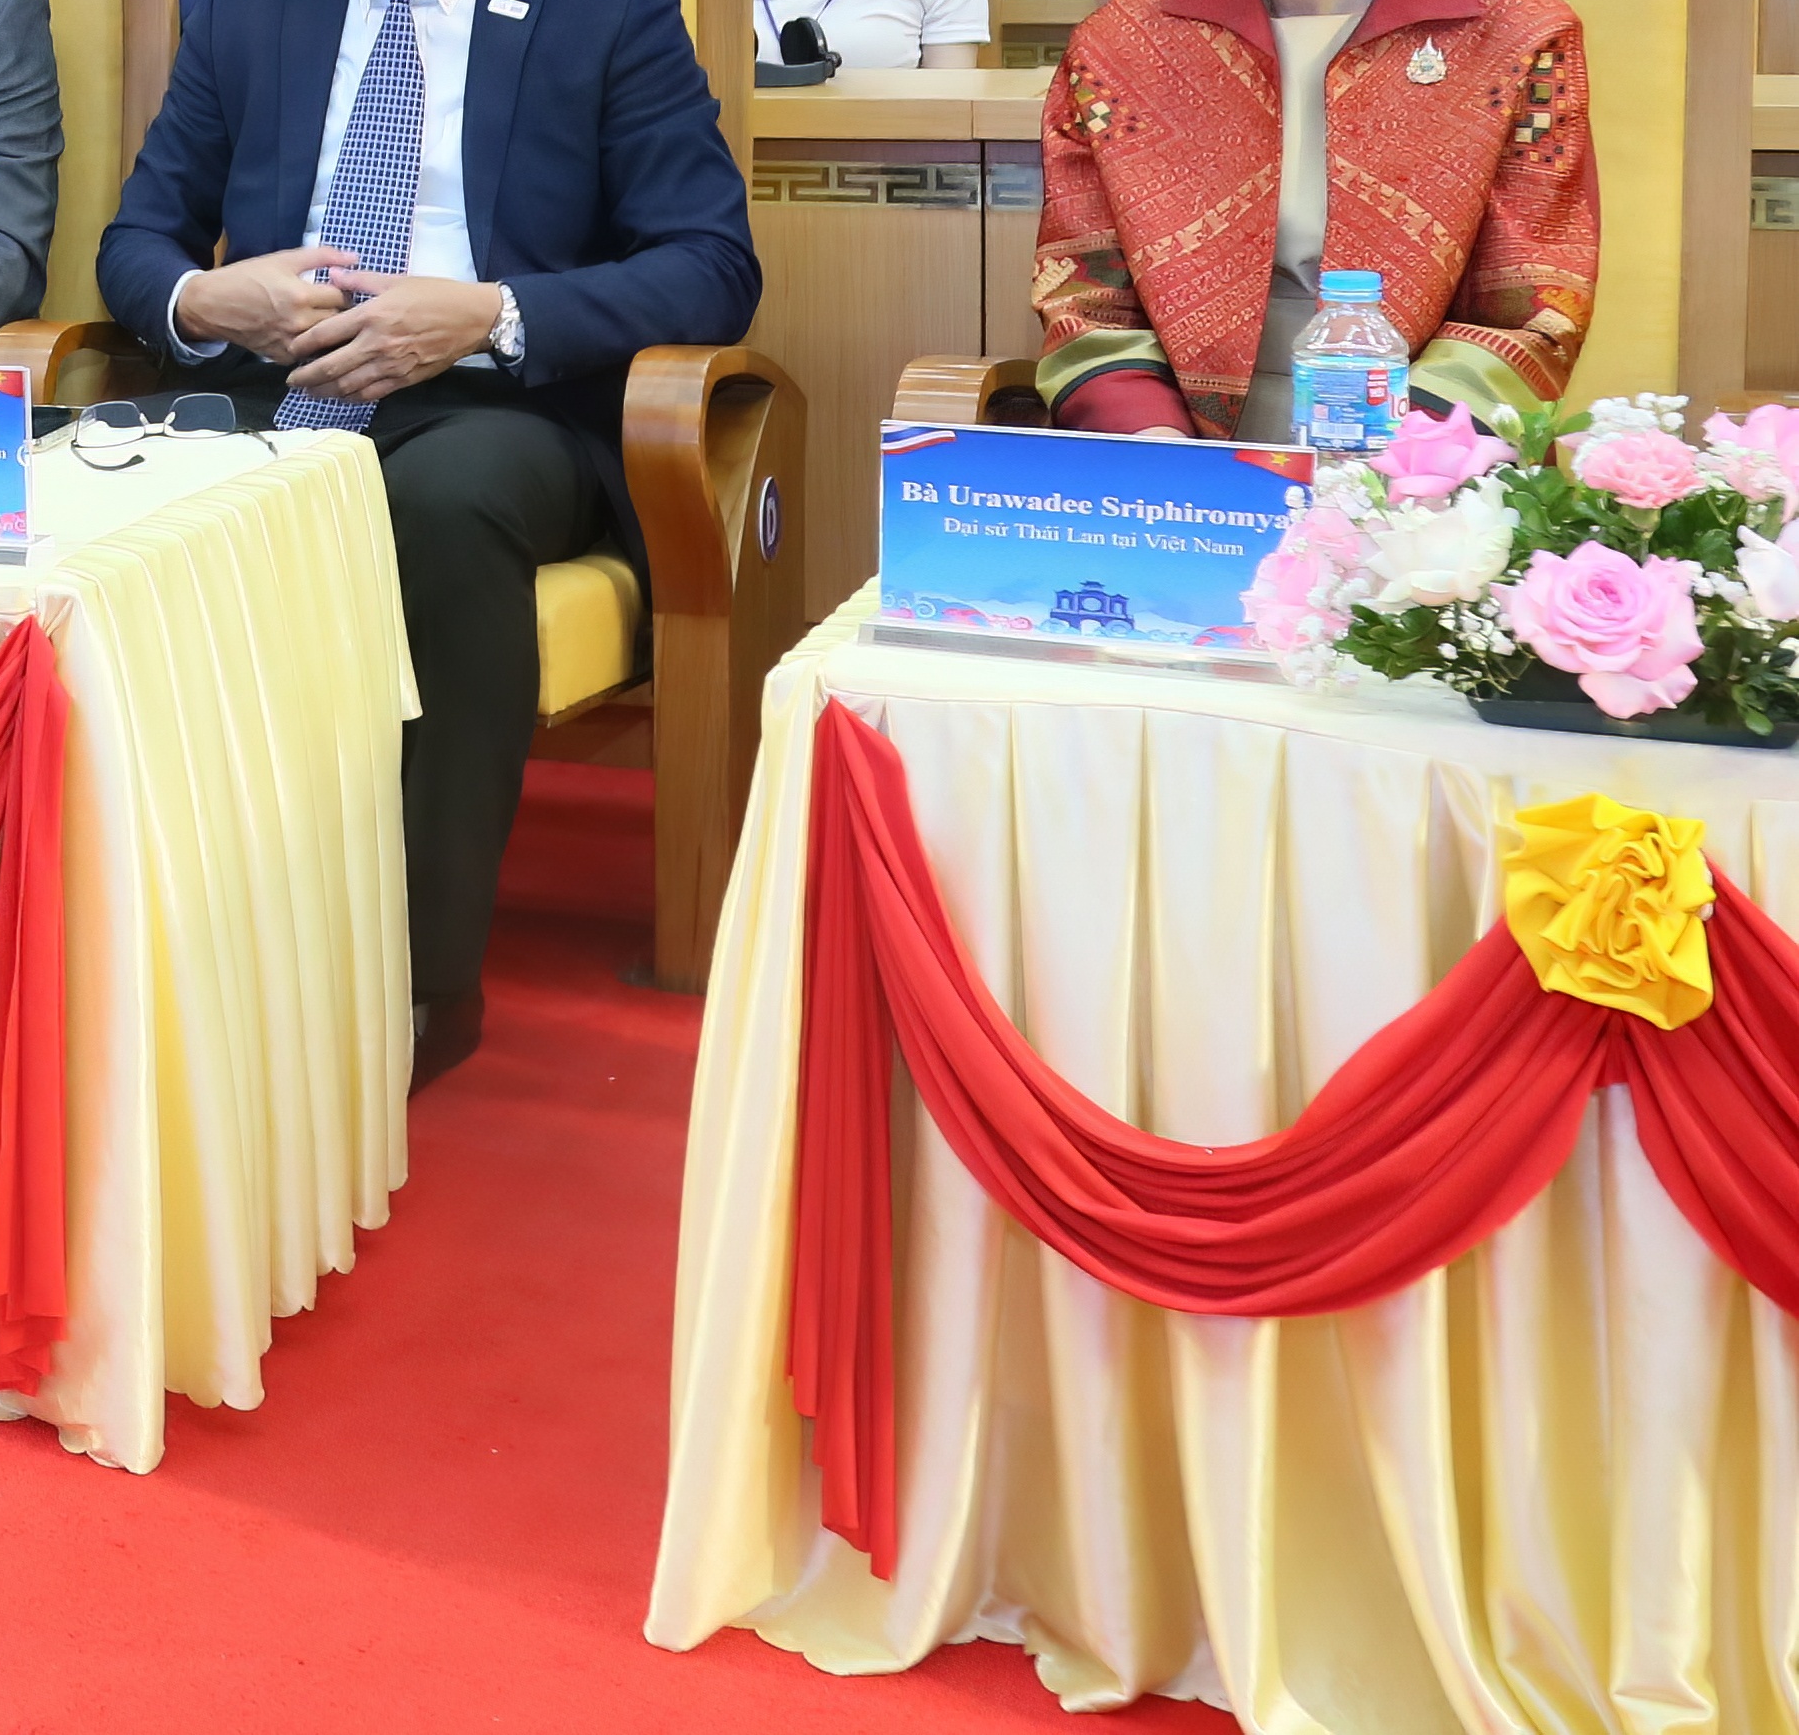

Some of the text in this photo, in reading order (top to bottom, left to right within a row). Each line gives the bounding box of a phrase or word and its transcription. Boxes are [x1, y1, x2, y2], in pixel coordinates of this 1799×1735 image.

[901, 481, 940, 504] Bà
[948, 485, 1094, 515] Urawadee
[1015, 523, 1060, 543] Thái
[1067, 527, 1105, 547] Lan
[1144, 534, 1188, 553] Việt
[1193, 537, 1246, 557] Nam
